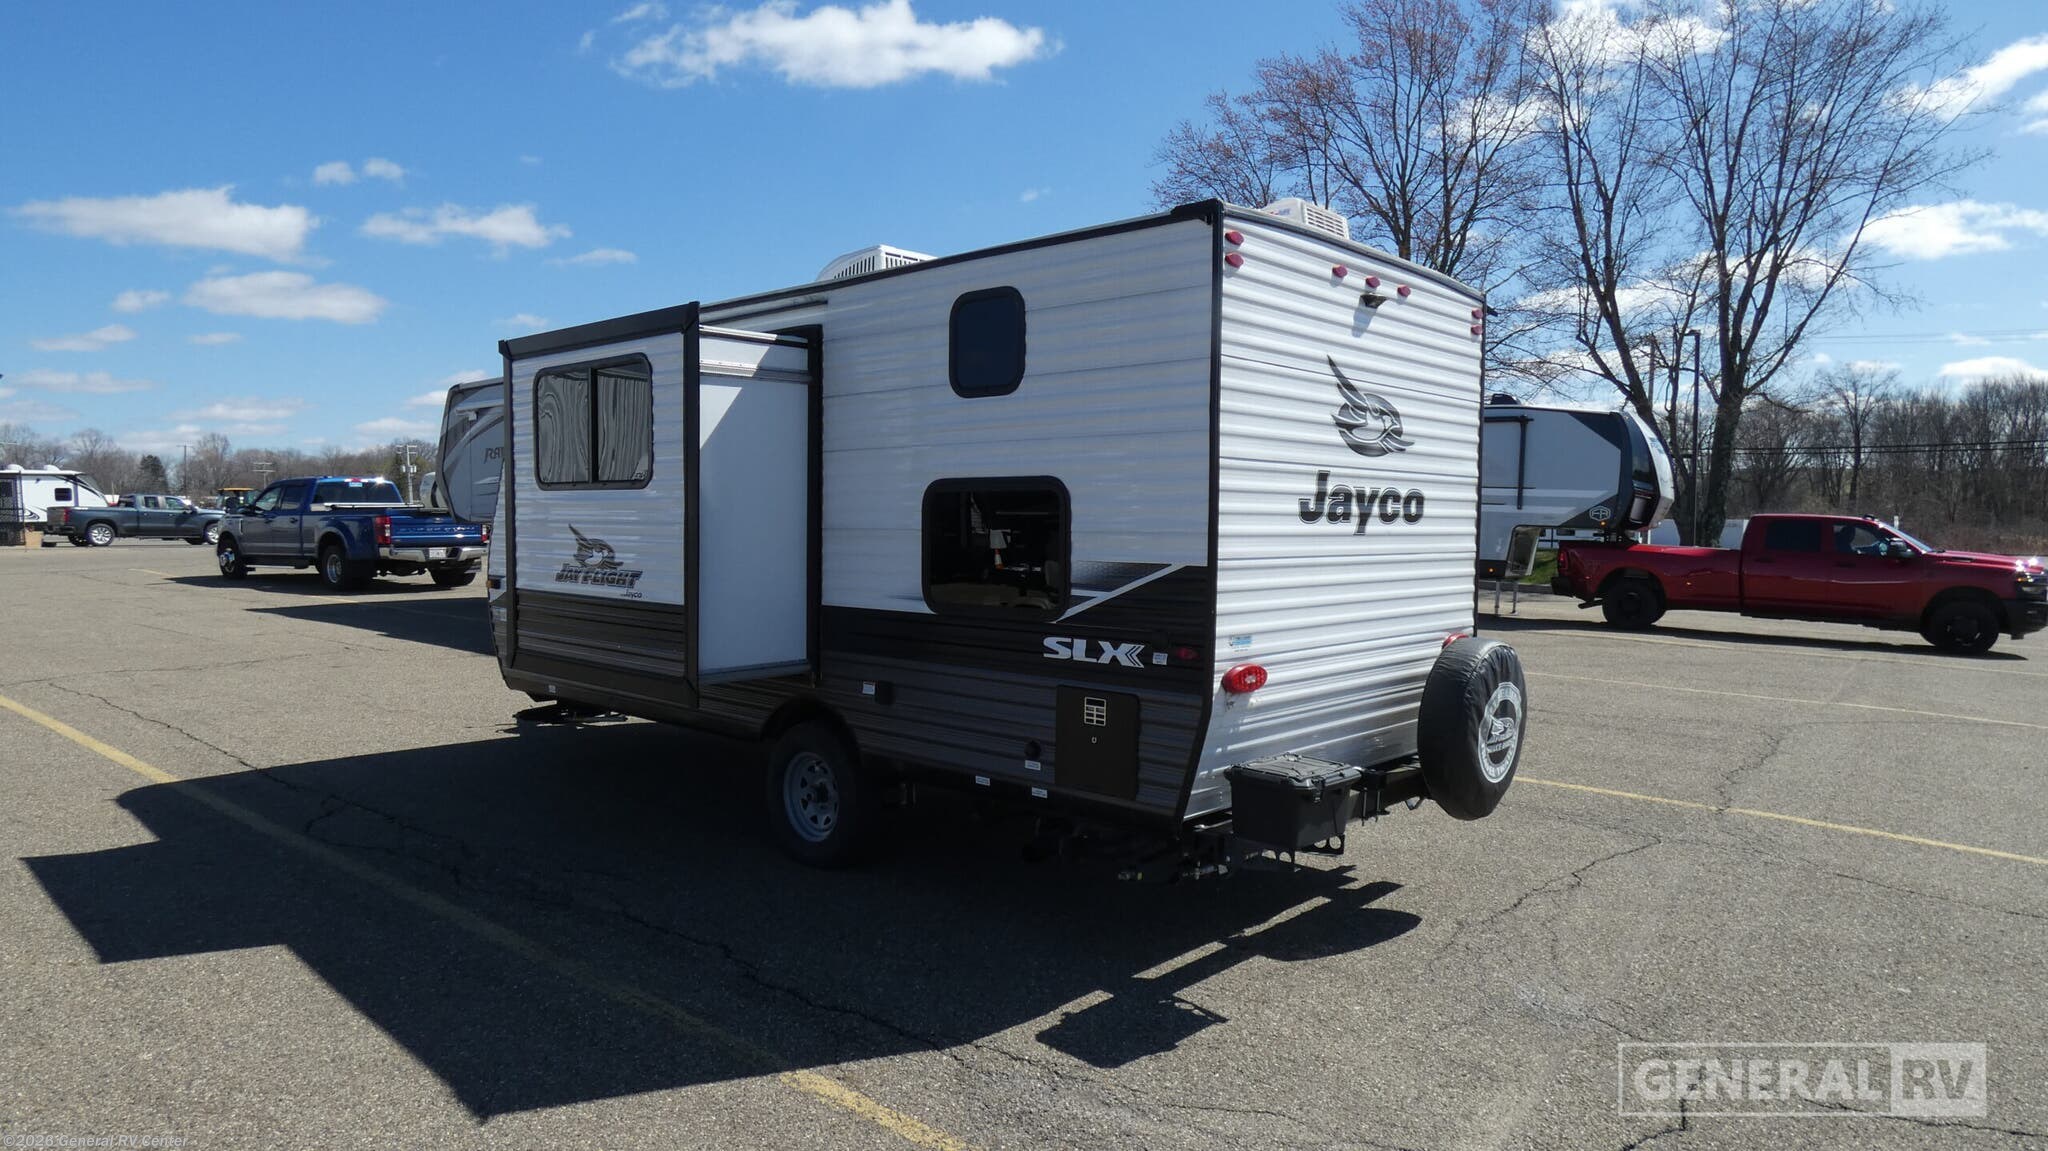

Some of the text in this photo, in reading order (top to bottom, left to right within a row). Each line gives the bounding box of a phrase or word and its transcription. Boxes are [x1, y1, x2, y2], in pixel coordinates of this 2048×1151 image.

[1298, 469, 1425, 536] Jayco
[555, 563, 643, 588] JAY FLIGHT
[1043, 636, 1145, 669] SLX
